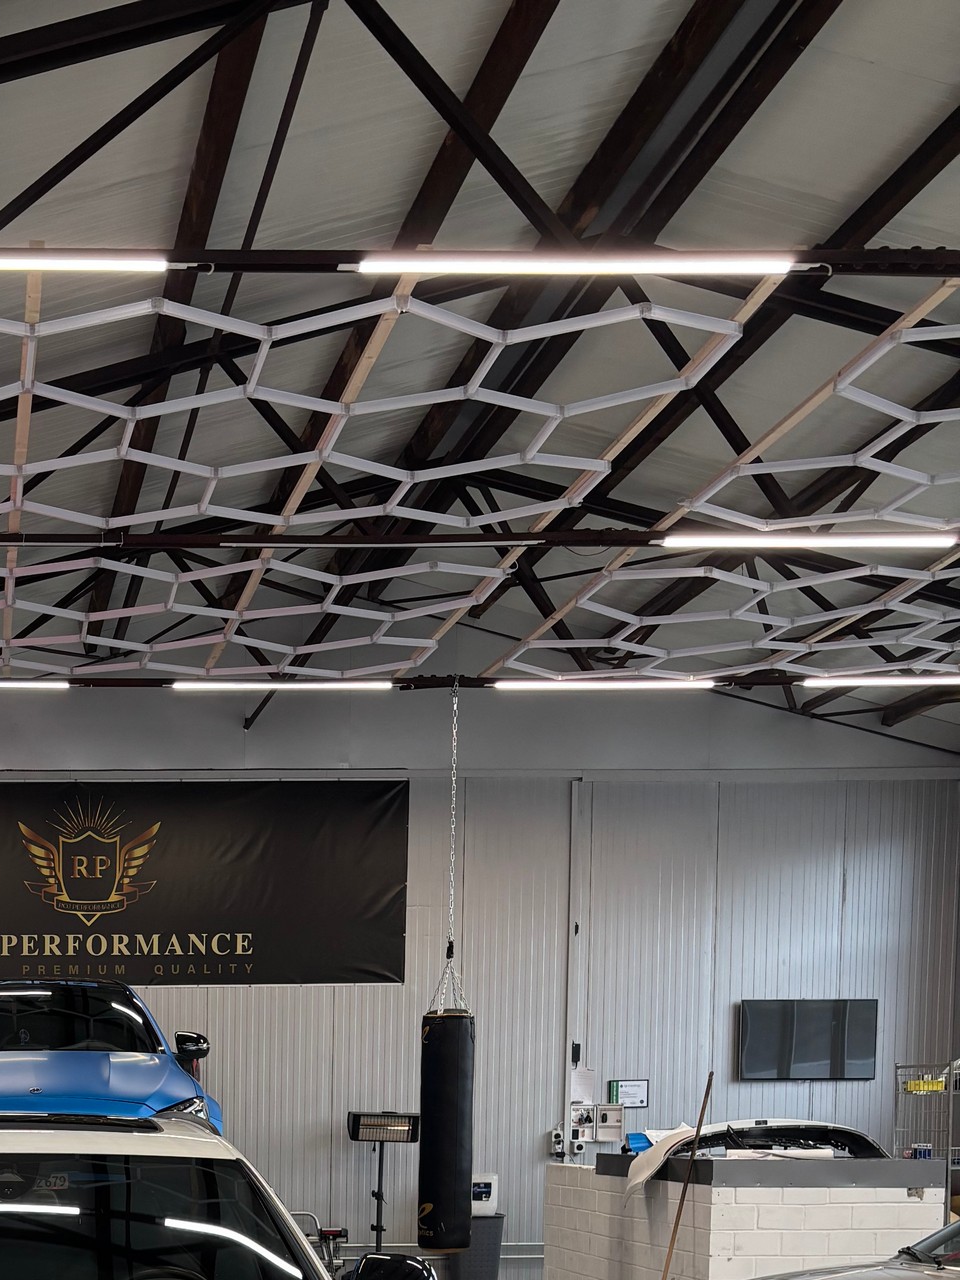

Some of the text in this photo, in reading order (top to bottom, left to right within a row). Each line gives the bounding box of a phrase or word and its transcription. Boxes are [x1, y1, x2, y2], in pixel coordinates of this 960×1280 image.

[71, 855, 111, 878] RP
[0, 932, 254, 957] PERFORMANCE
[22, 964, 126, 976] PREMIUM
[153, 963, 254, 975] QUALITY
